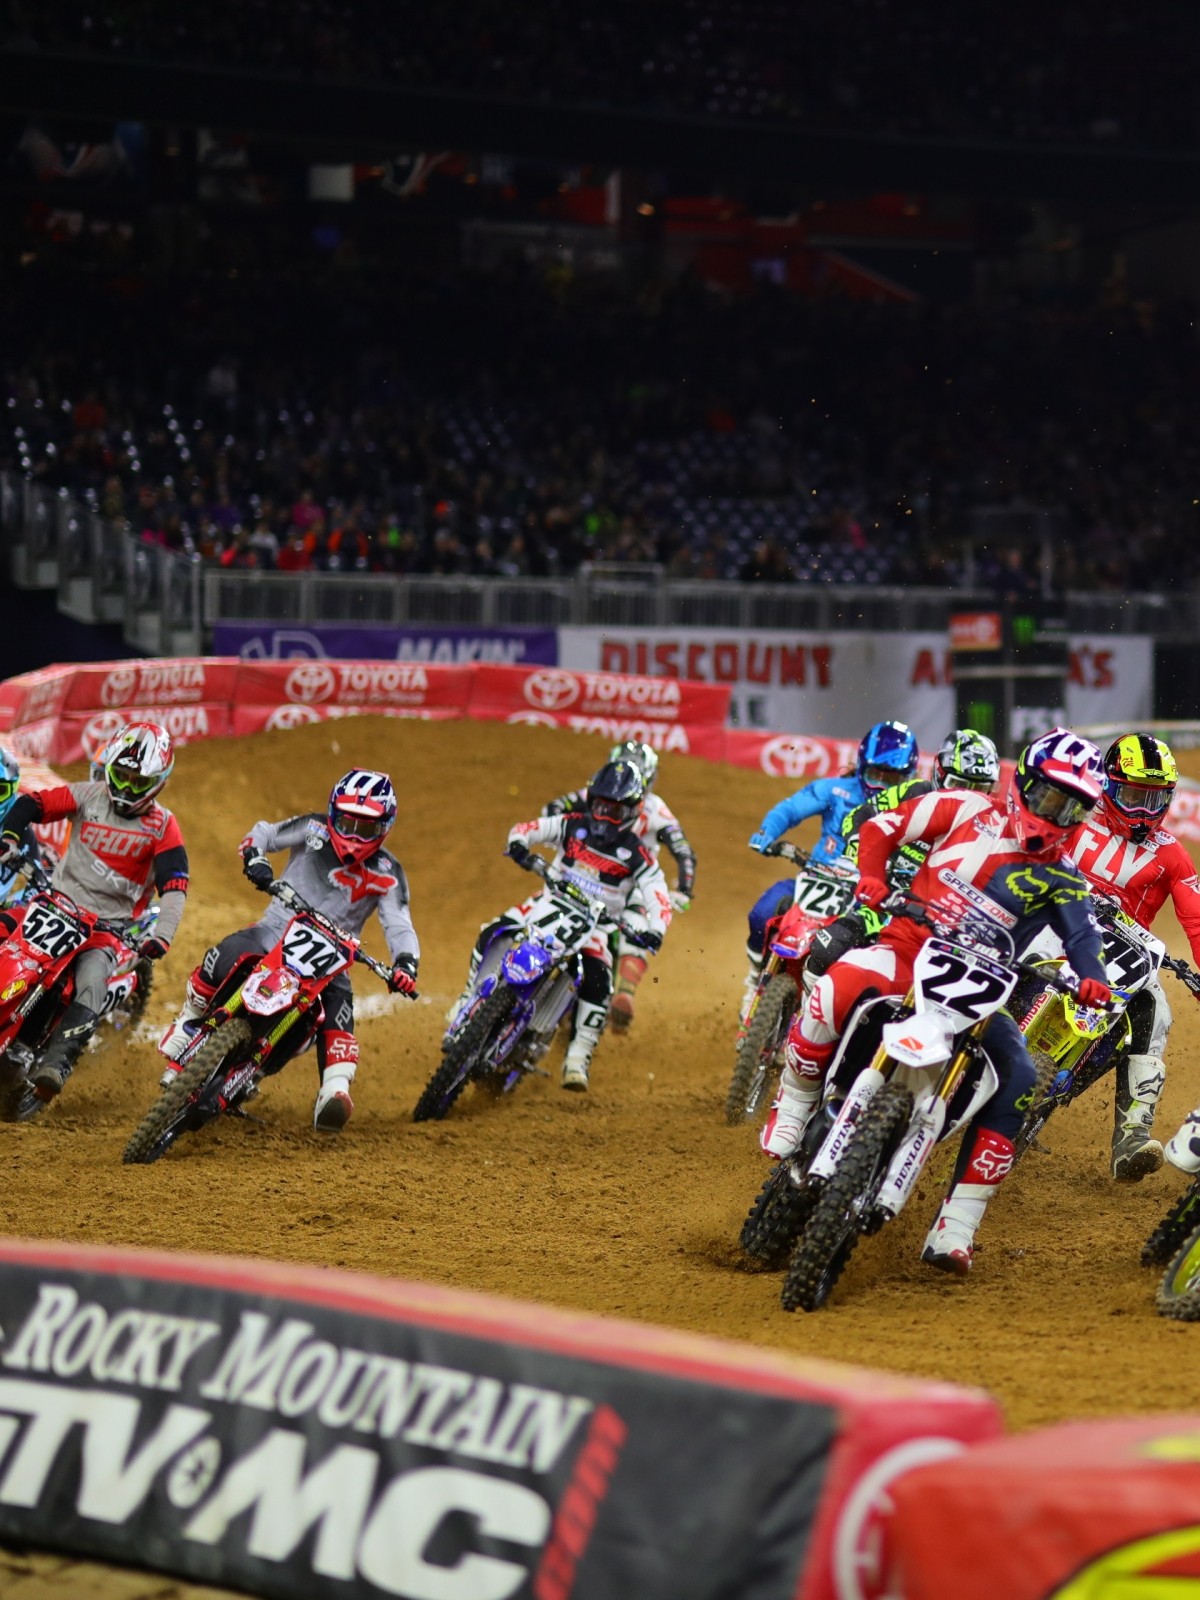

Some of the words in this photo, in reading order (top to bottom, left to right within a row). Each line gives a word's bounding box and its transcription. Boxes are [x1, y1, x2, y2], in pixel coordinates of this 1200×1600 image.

[140, 665, 206, 690] TOYOTA
[339, 666, 429, 691] TOYOTA
[584, 675, 681, 705] TOYOTA
[602, 641, 832, 690] DISCOUNT
[82, 826, 153, 858] SHOT
[1072, 820, 1158, 889] FLY
[798, 877, 855, 917] 723
[22, 905, 82, 959] 526
[533, 898, 592, 948] 73
[202, 947, 220, 979] FOX
[282, 929, 341, 979] 214
[810, 985, 829, 1025] FOX
[920, 953, 1007, 1020] 22
[893, 1129, 927, 1191] DUNLOP
[2, 1279, 221, 1392] ROCKY
[200, 1310, 596, 1474] MOUNTAIN
